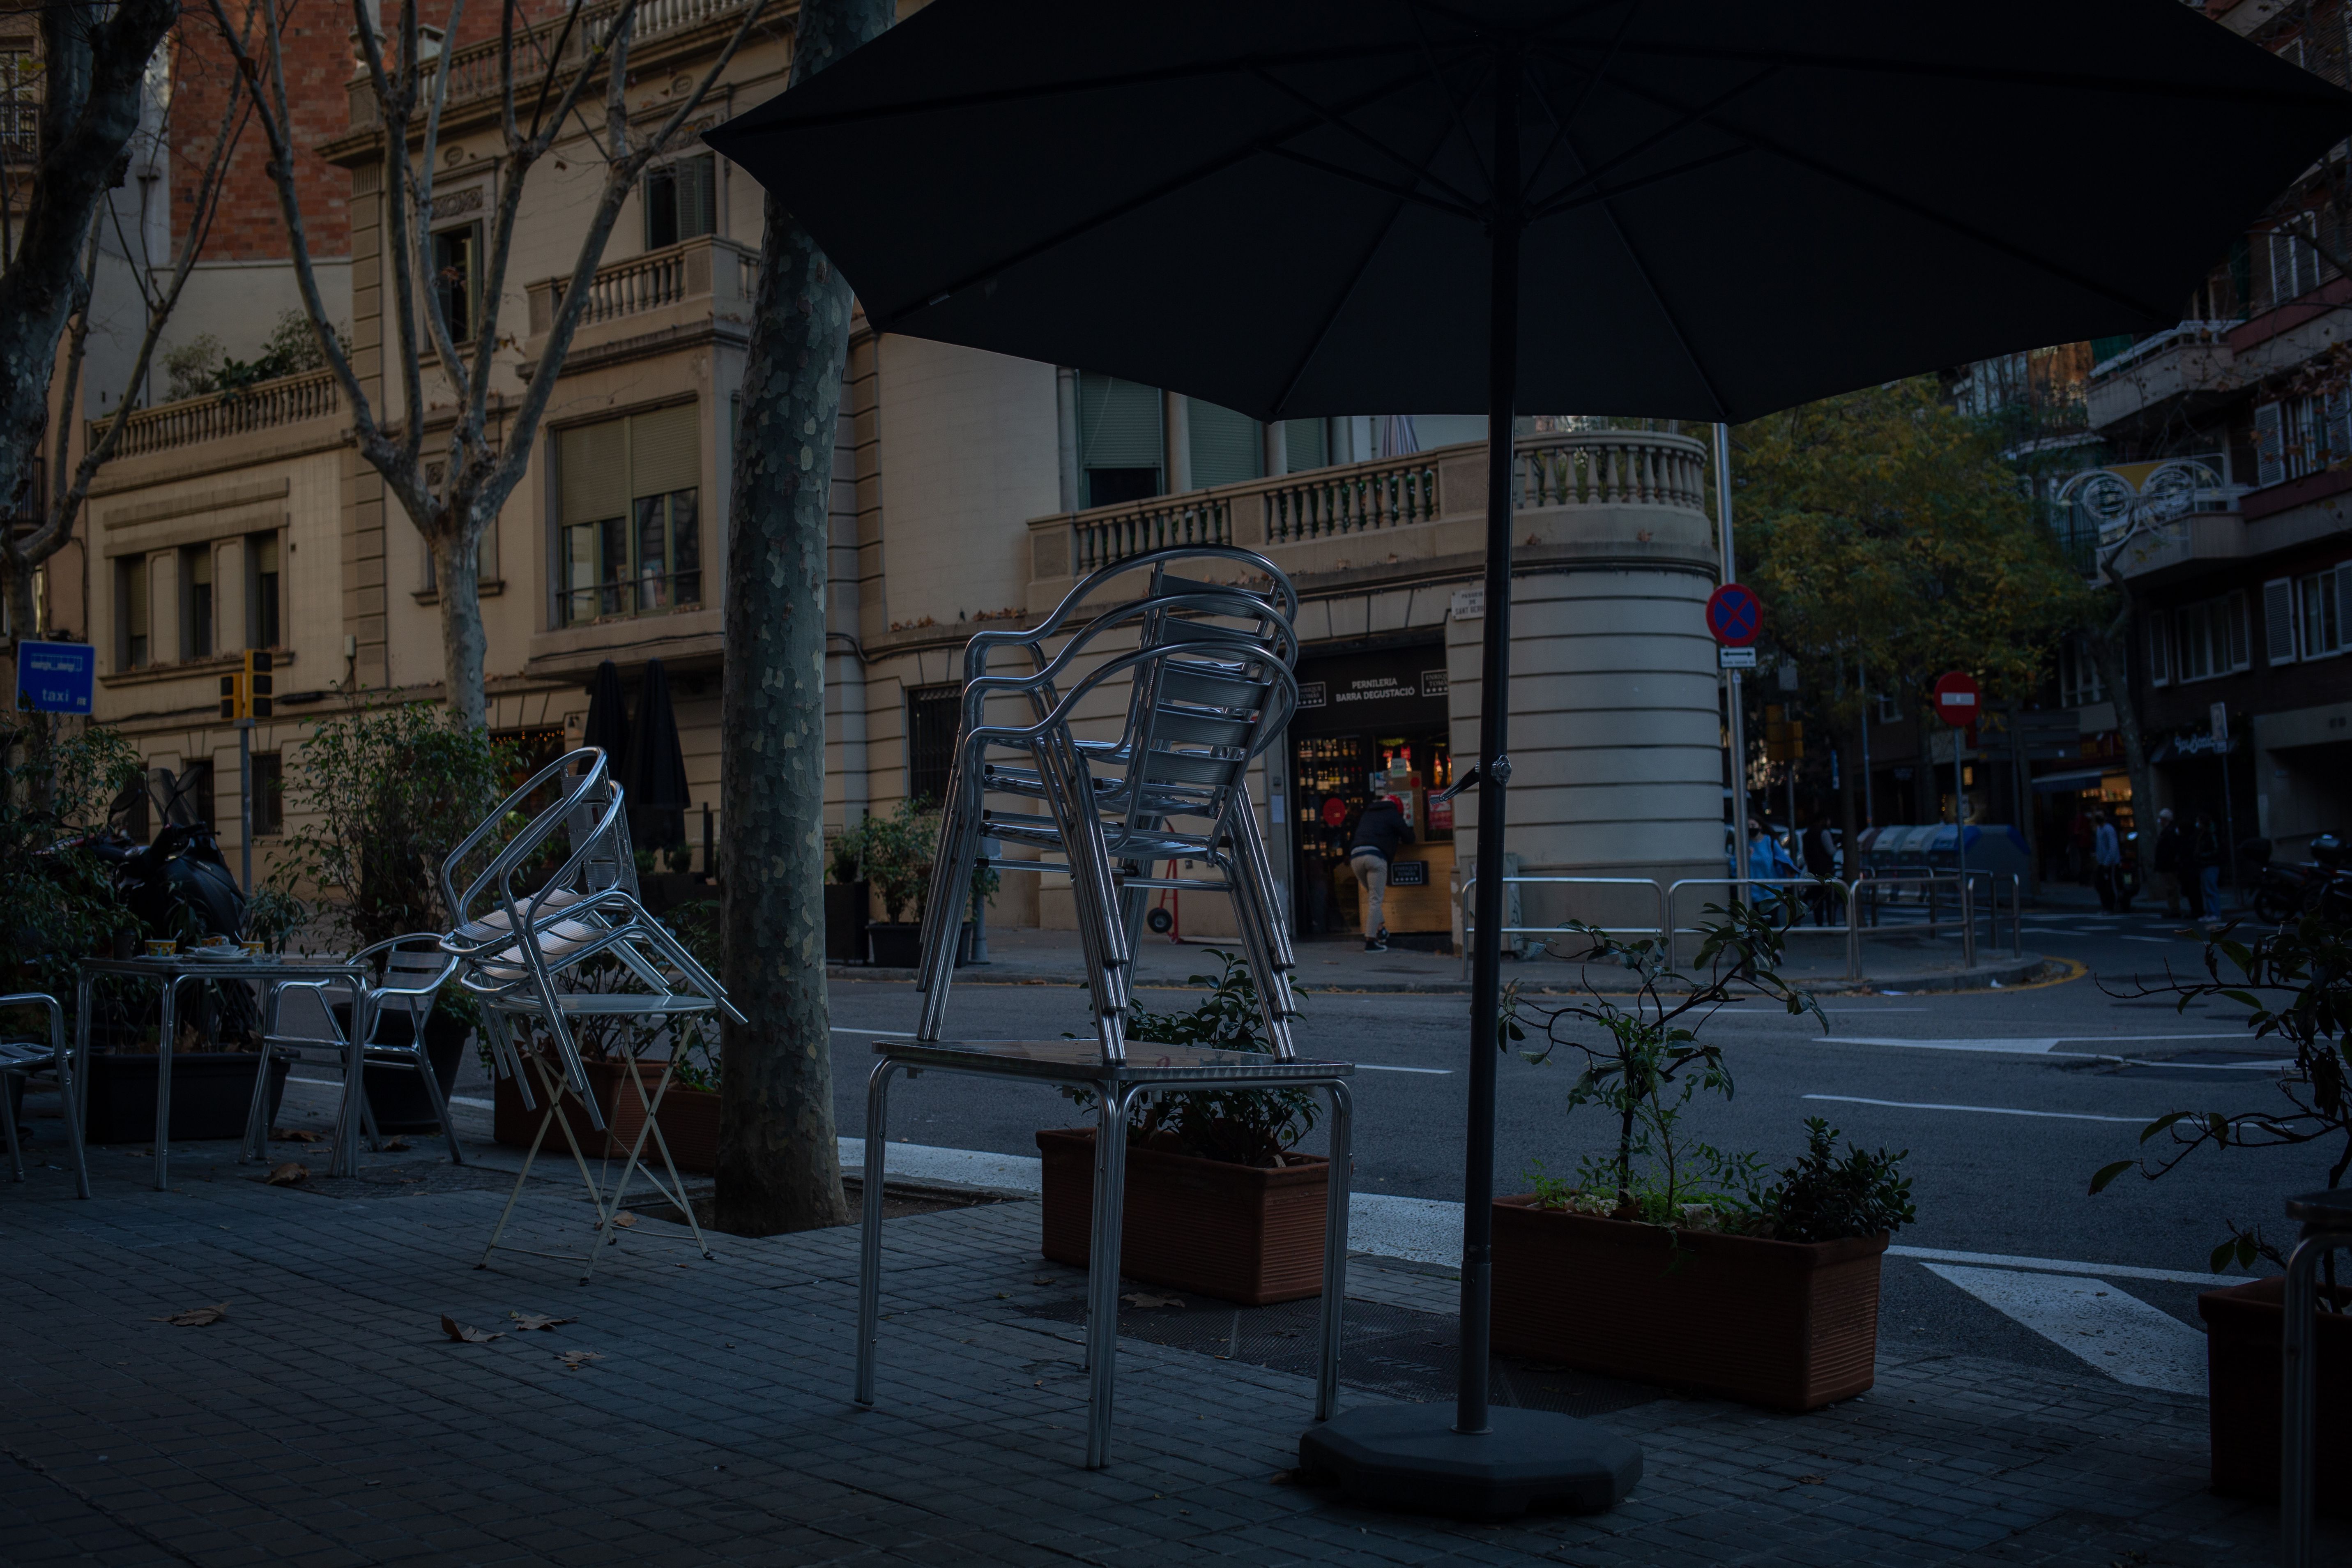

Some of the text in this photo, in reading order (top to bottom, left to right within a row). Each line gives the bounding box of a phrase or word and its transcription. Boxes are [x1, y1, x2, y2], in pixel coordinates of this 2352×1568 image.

[1455, 607, 1468, 615] SANT
[1351, 677, 1398, 690] PERNILERIA
[42, 688, 69, 702] taxi
[1336, 686, 1415, 702] BARRA DEGUSTACIÓ
